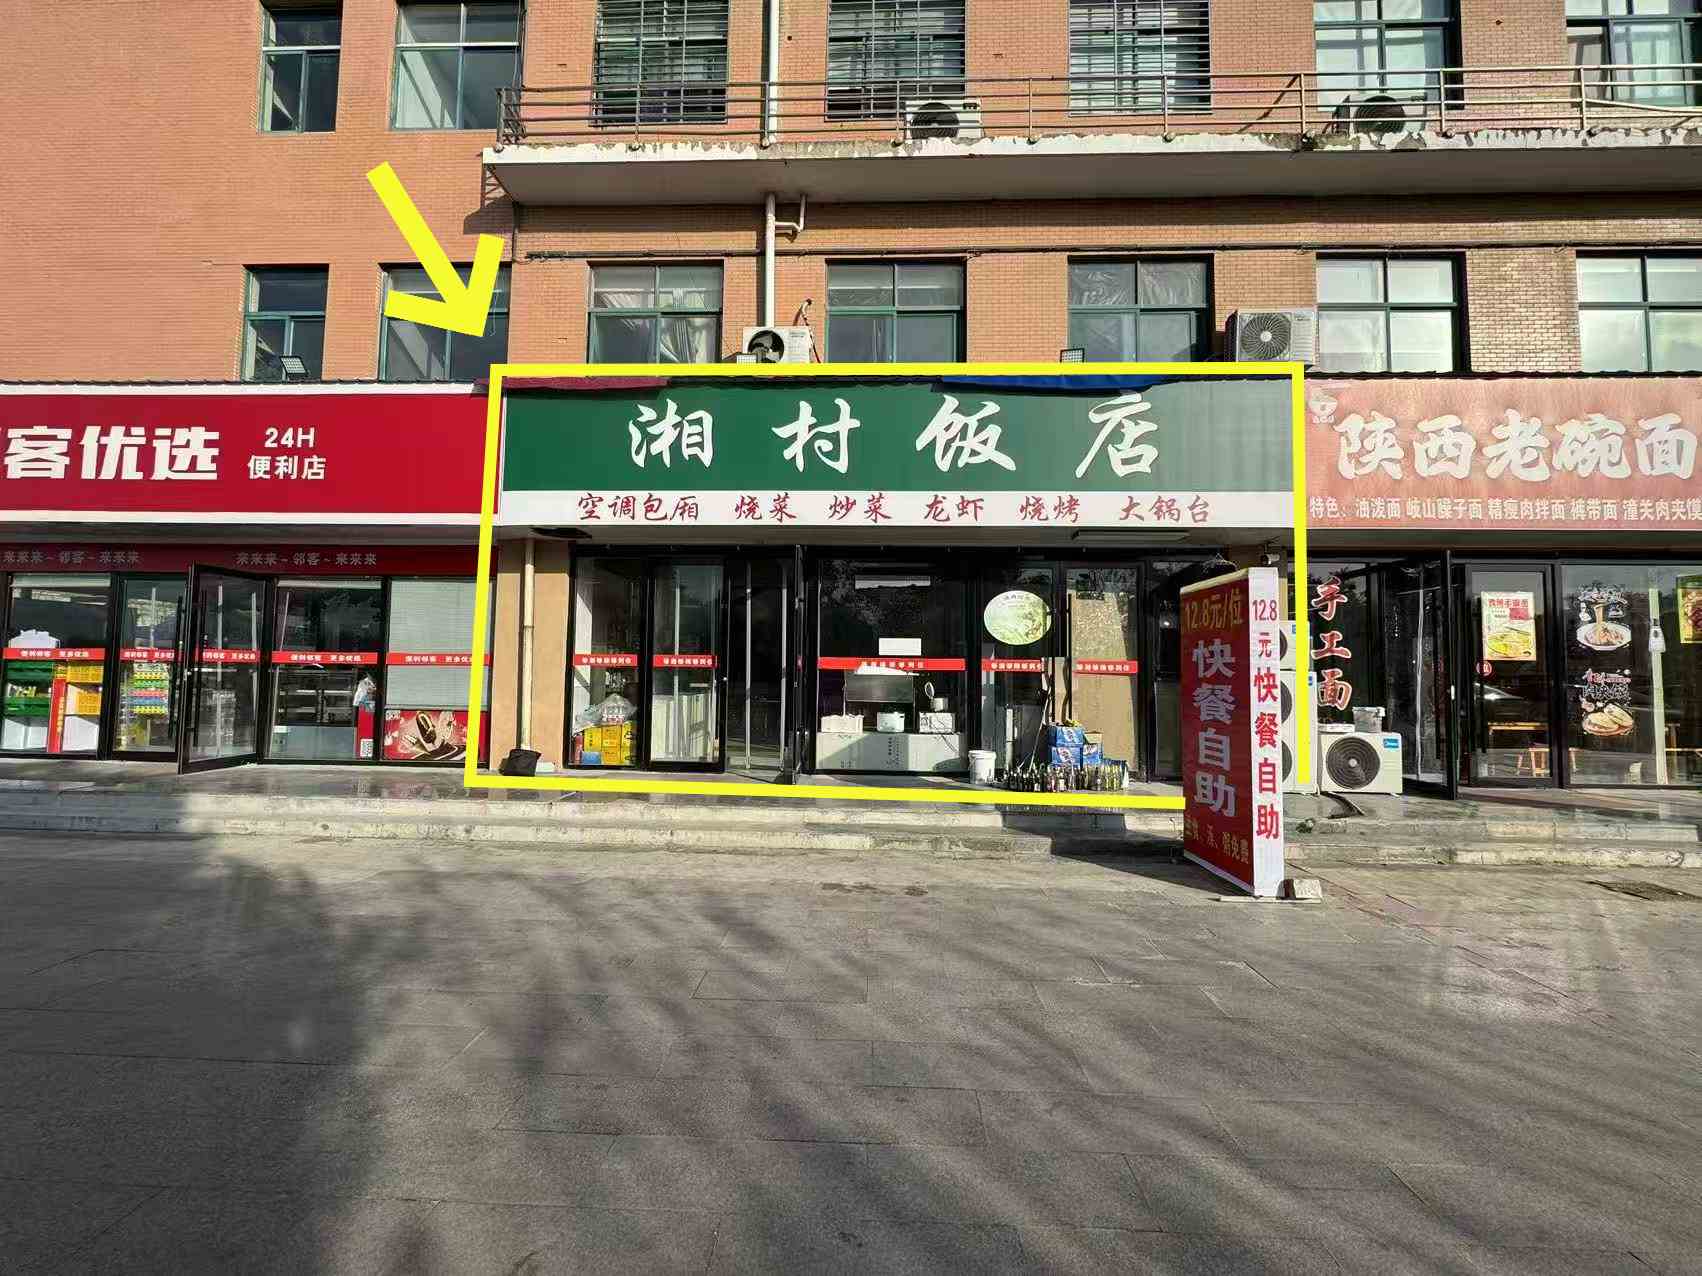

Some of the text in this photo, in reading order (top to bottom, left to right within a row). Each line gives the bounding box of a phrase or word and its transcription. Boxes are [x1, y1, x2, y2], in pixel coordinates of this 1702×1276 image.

[264, 427, 316, 449] 24H
[627, 392, 1159, 478] 湘村饭店
[1333, 408, 1698, 482] 陕西老碗面
[247, 454, 327, 480] 便利店
[577, 493, 1212, 524] 空调包厢 烧菜 炒菜 龙虾 烧烤 大锅台
[1184, 587, 1244, 633] 12.8元/位
[1311, 576, 1353, 711] 手工面
[1192, 638, 1237, 818] 快餐自助
